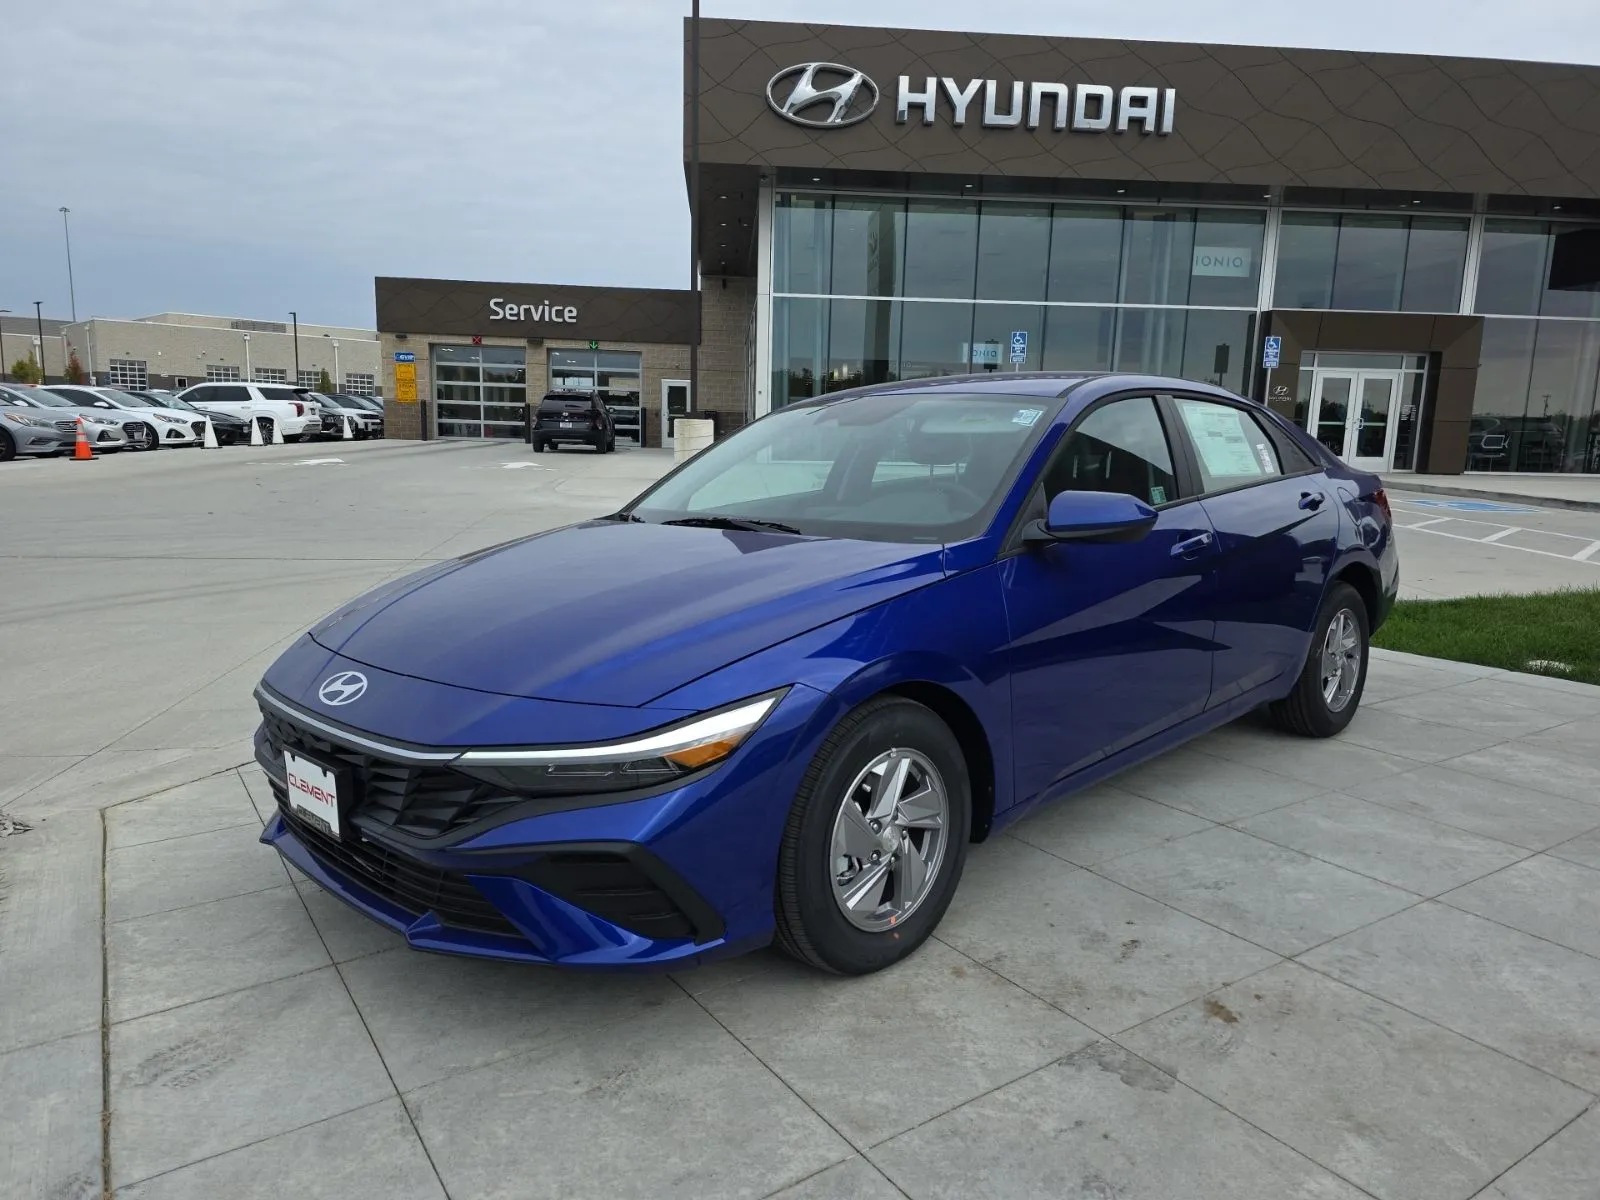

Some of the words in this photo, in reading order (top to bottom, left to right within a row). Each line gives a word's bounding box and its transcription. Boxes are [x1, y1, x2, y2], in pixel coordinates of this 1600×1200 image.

[896, 75, 1176, 135] HYUNDAI
[489, 297, 578, 323] Service
[288, 773, 335, 807] CLEMENT
